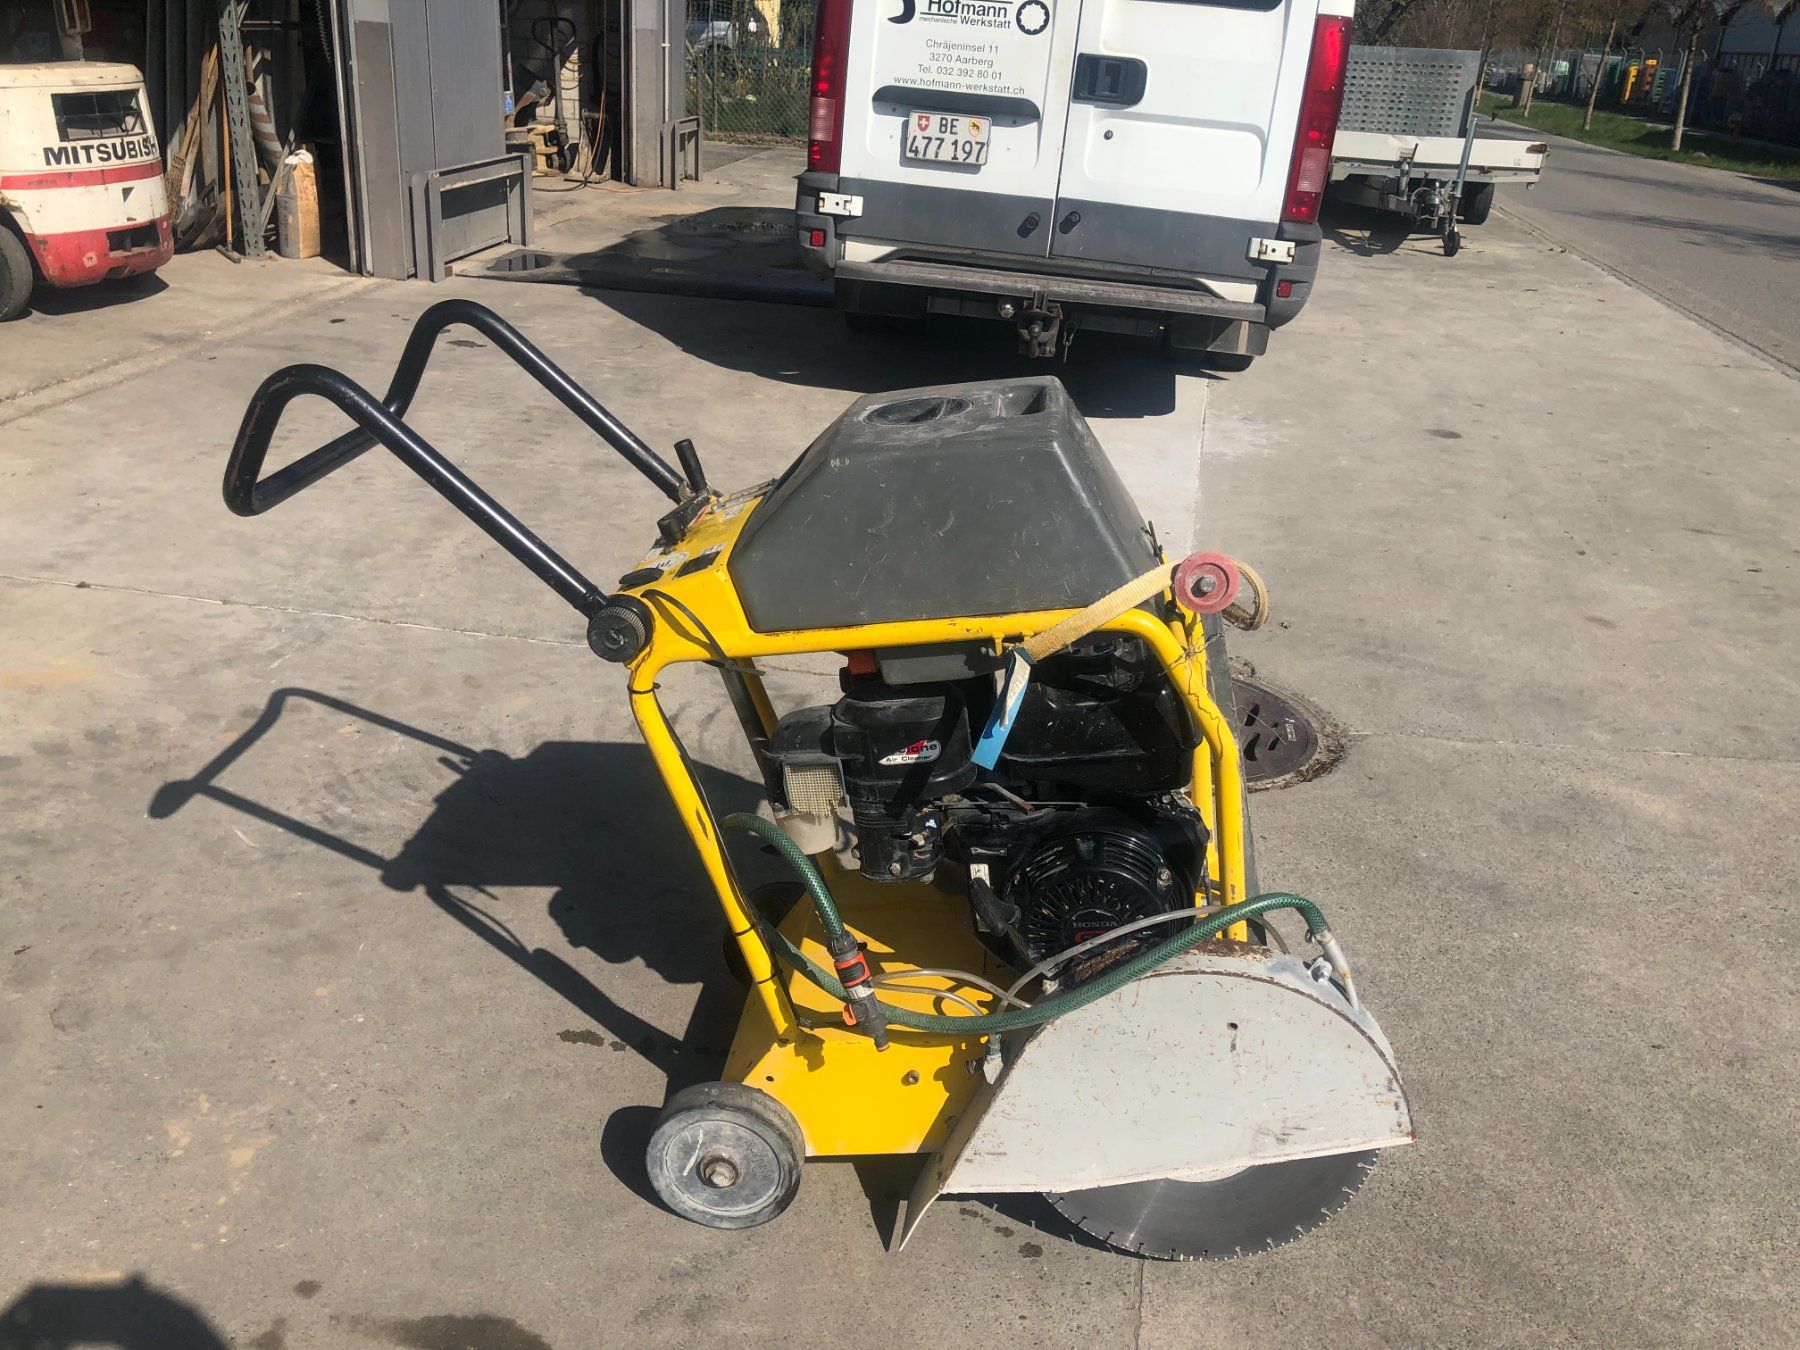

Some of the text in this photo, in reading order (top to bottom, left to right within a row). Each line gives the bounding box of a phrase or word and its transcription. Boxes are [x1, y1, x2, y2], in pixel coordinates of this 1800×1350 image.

[928, 0, 1008, 18] Hofmann
[919, 16, 1011, 29] mechanische Werkstatt
[925, 39, 999, 54] Chräjeninsel 11
[929, 52, 994, 68] 3270 Aarberg
[918, 63, 1002, 80] Tel. 032 392 80 01
[893, 76, 1025, 95] www.hofmann-werkstatt.ch
[939, 117, 960, 135] BE
[43, 136, 157, 166] MITSUBISH
[908, 135, 986, 163] 477 197
[1073, 921, 1119, 929] HONDA
